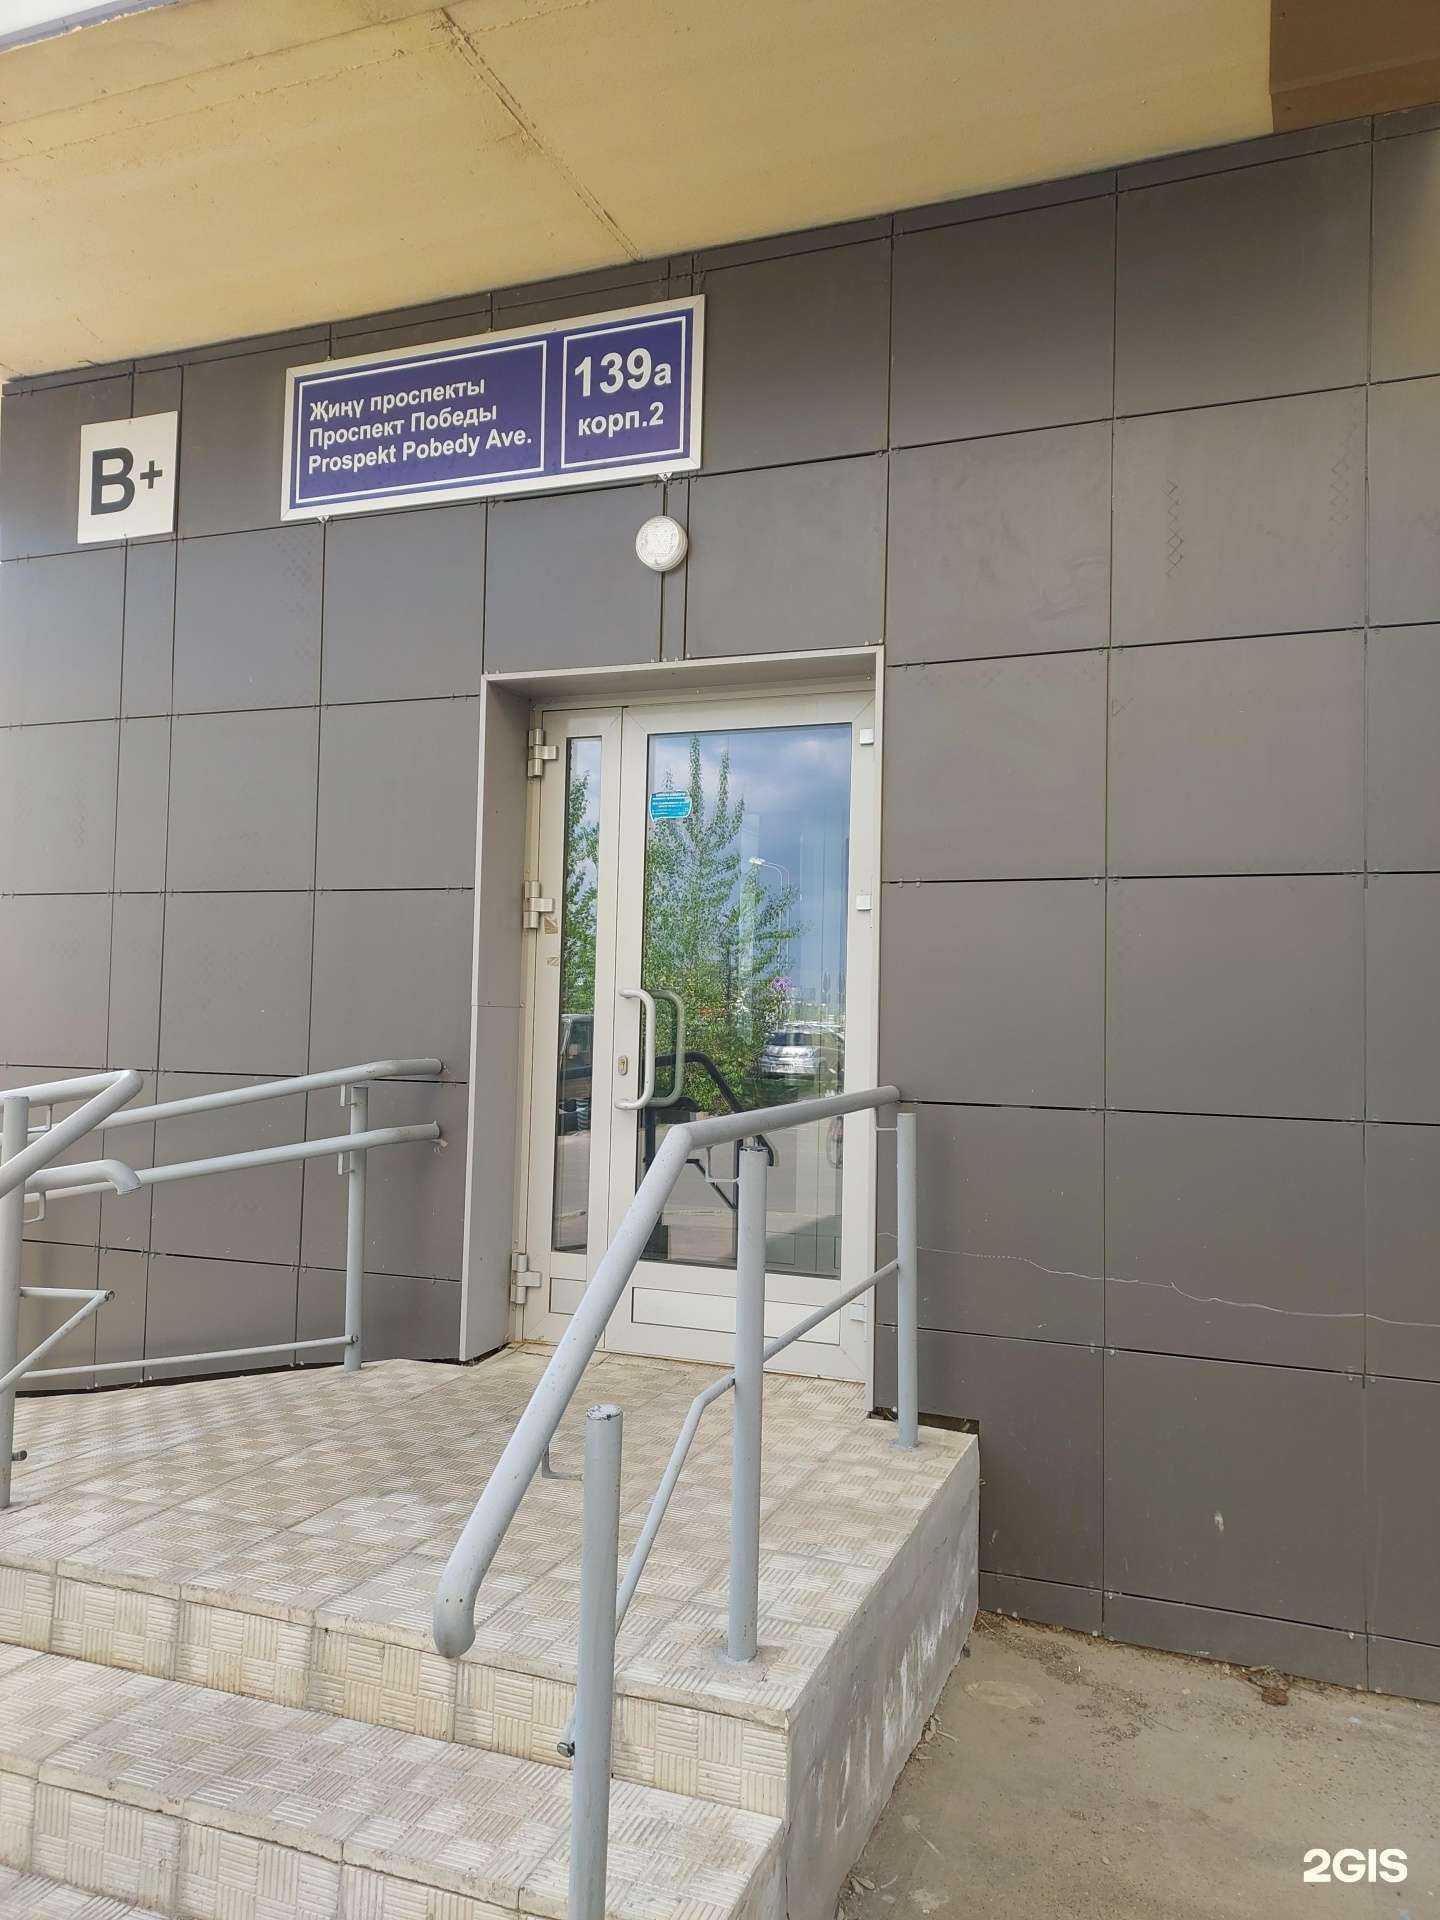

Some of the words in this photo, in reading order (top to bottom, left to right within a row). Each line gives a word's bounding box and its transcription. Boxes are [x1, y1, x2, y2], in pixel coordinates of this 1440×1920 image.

[574, 348, 672, 397] 139а
[309, 399, 365, 422] Җиңү
[370, 379, 485, 414] проспекты
[578, 401, 664, 438] корп.2
[309, 419, 405, 450] Проспект
[411, 405, 497, 432] Победы
[308, 444, 397, 474] Prospekt
[402, 432, 480, 461] Pobedy
[485, 428, 532, 449] Ave.
[90, 447, 163, 516] B+
